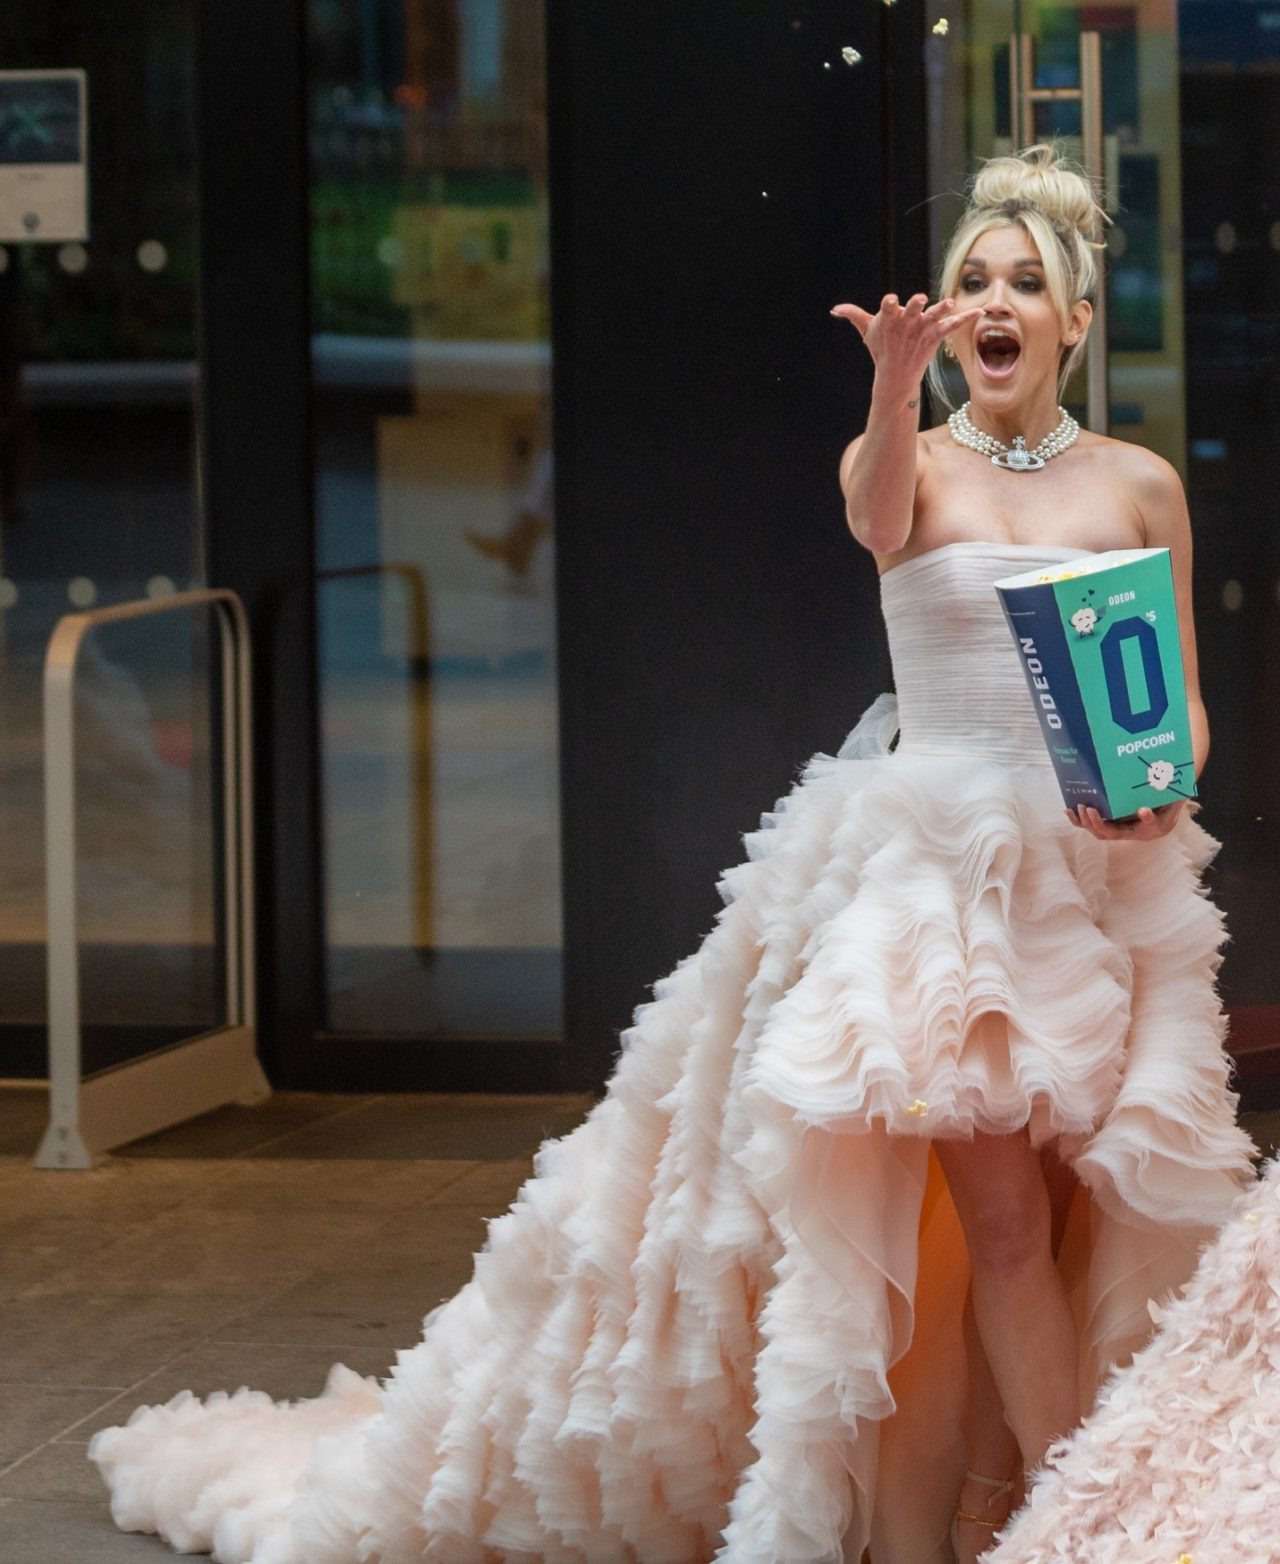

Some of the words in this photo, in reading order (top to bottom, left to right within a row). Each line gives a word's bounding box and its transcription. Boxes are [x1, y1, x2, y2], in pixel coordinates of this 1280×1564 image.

[1108, 590, 1136, 606] ODEON
[1019, 637, 1062, 730] ODEON
[1116, 731, 1175, 757] POPCORN
